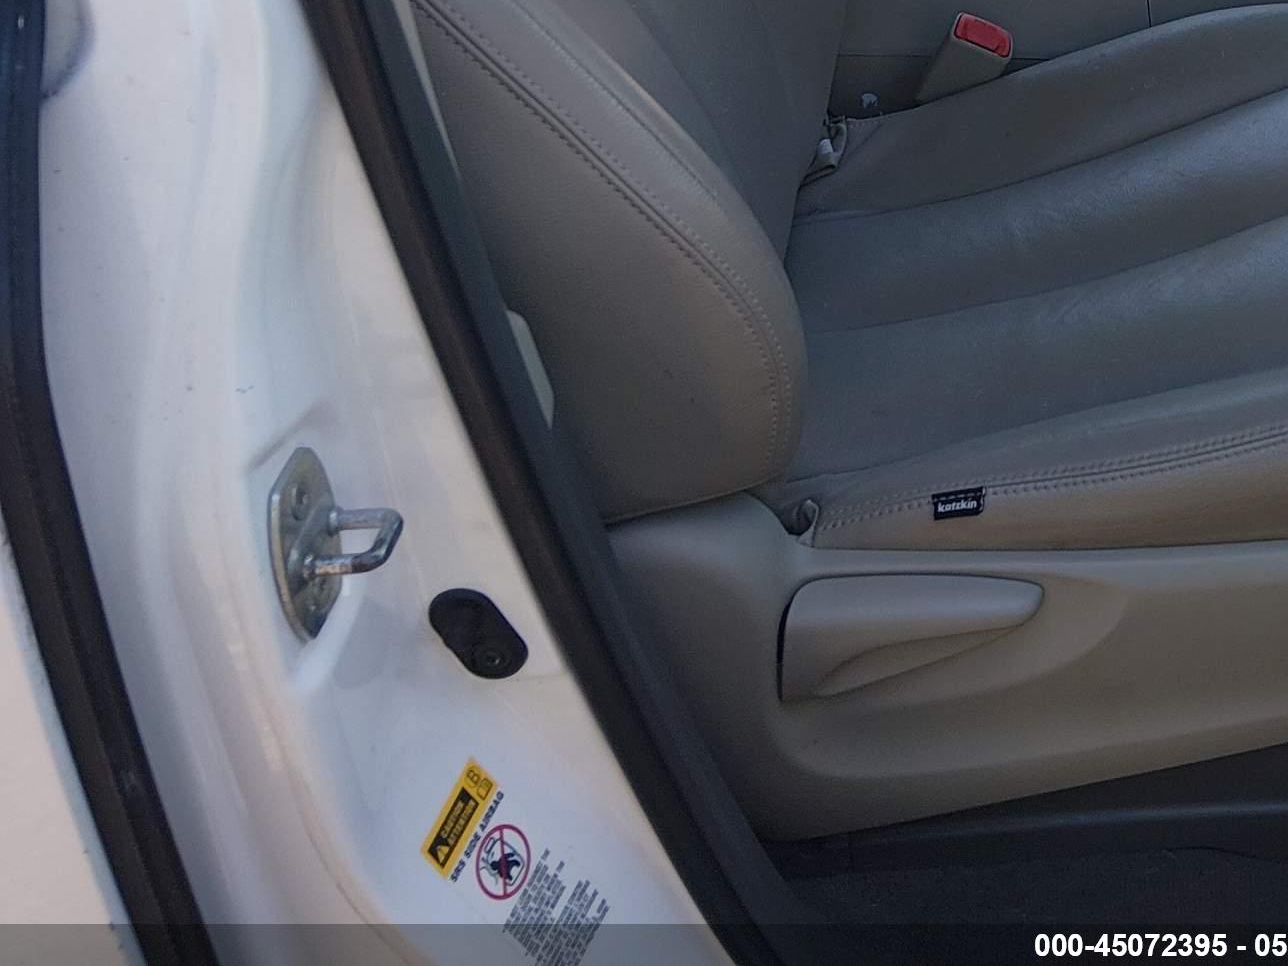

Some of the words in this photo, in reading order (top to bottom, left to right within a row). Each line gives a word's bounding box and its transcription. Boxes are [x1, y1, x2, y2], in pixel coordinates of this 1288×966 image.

[937, 498, 978, 513] katzkin
[450, 859, 466, 882] SRS
[464, 832, 481, 859] SIDE
[479, 791, 505, 832] AIRBAG
